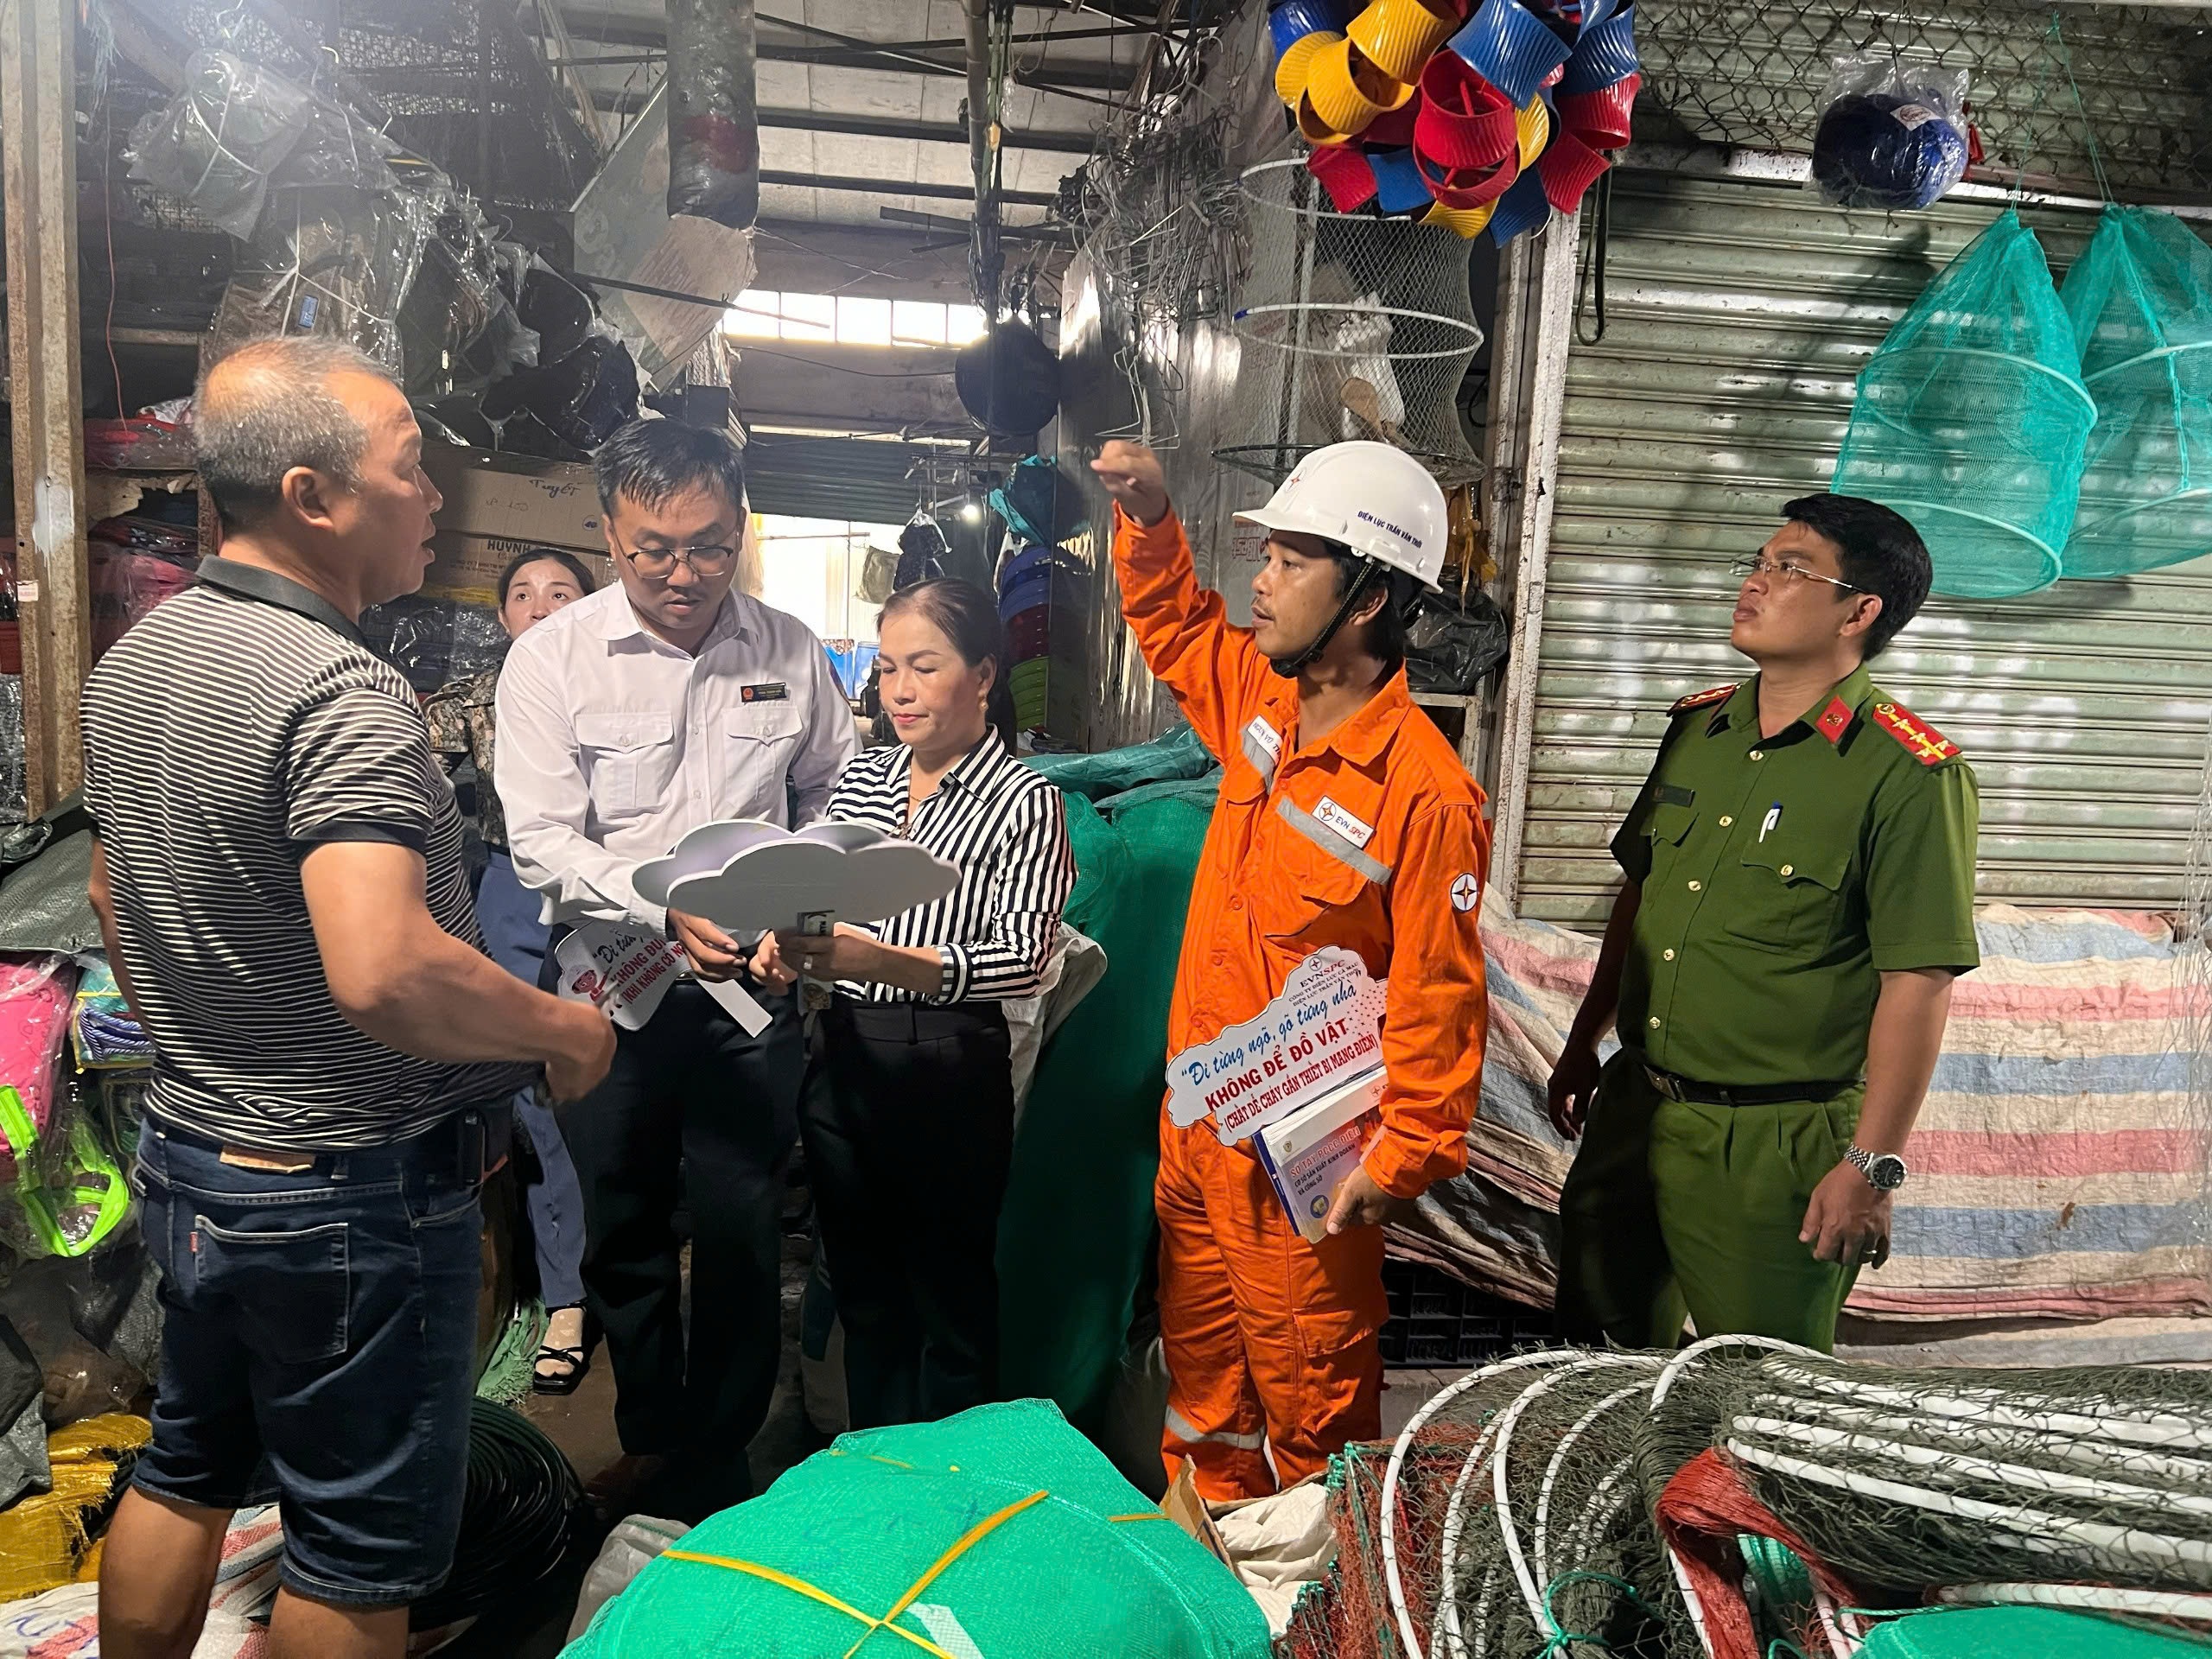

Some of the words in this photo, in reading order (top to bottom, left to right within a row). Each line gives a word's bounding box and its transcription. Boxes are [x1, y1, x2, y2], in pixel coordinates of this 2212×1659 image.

[1335, 816, 1350, 830] EVN
[1349, 825, 1366, 840] SPC
[611, 953, 650, 987] KHÔNG
[636, 962, 667, 988] KHÔNG
[661, 950, 677, 967] CÓ
[1300, 959, 1345, 988] EVNSPC
[1288, 992, 1304, 1002] CÔNG
[1213, 1047, 1245, 1073] từng
[1279, 1014, 1294, 1043] gõ
[1297, 999, 1328, 1026] từng
[1205, 1068, 1263, 1113] KHÔNG
[1262, 1045, 1287, 1078] ĐỂ
[1288, 1032, 1313, 1063] ĐỒ
[1315, 1019, 1348, 1047] VẬT
[1259, 1084, 1284, 1109] CHÁY
[1323, 1058, 1334, 1074] BỊ
[1330, 1046, 1359, 1071] MANG
[1301, 1153, 1319, 1169] TAY
[1319, 1139, 1340, 1159] PCCC
